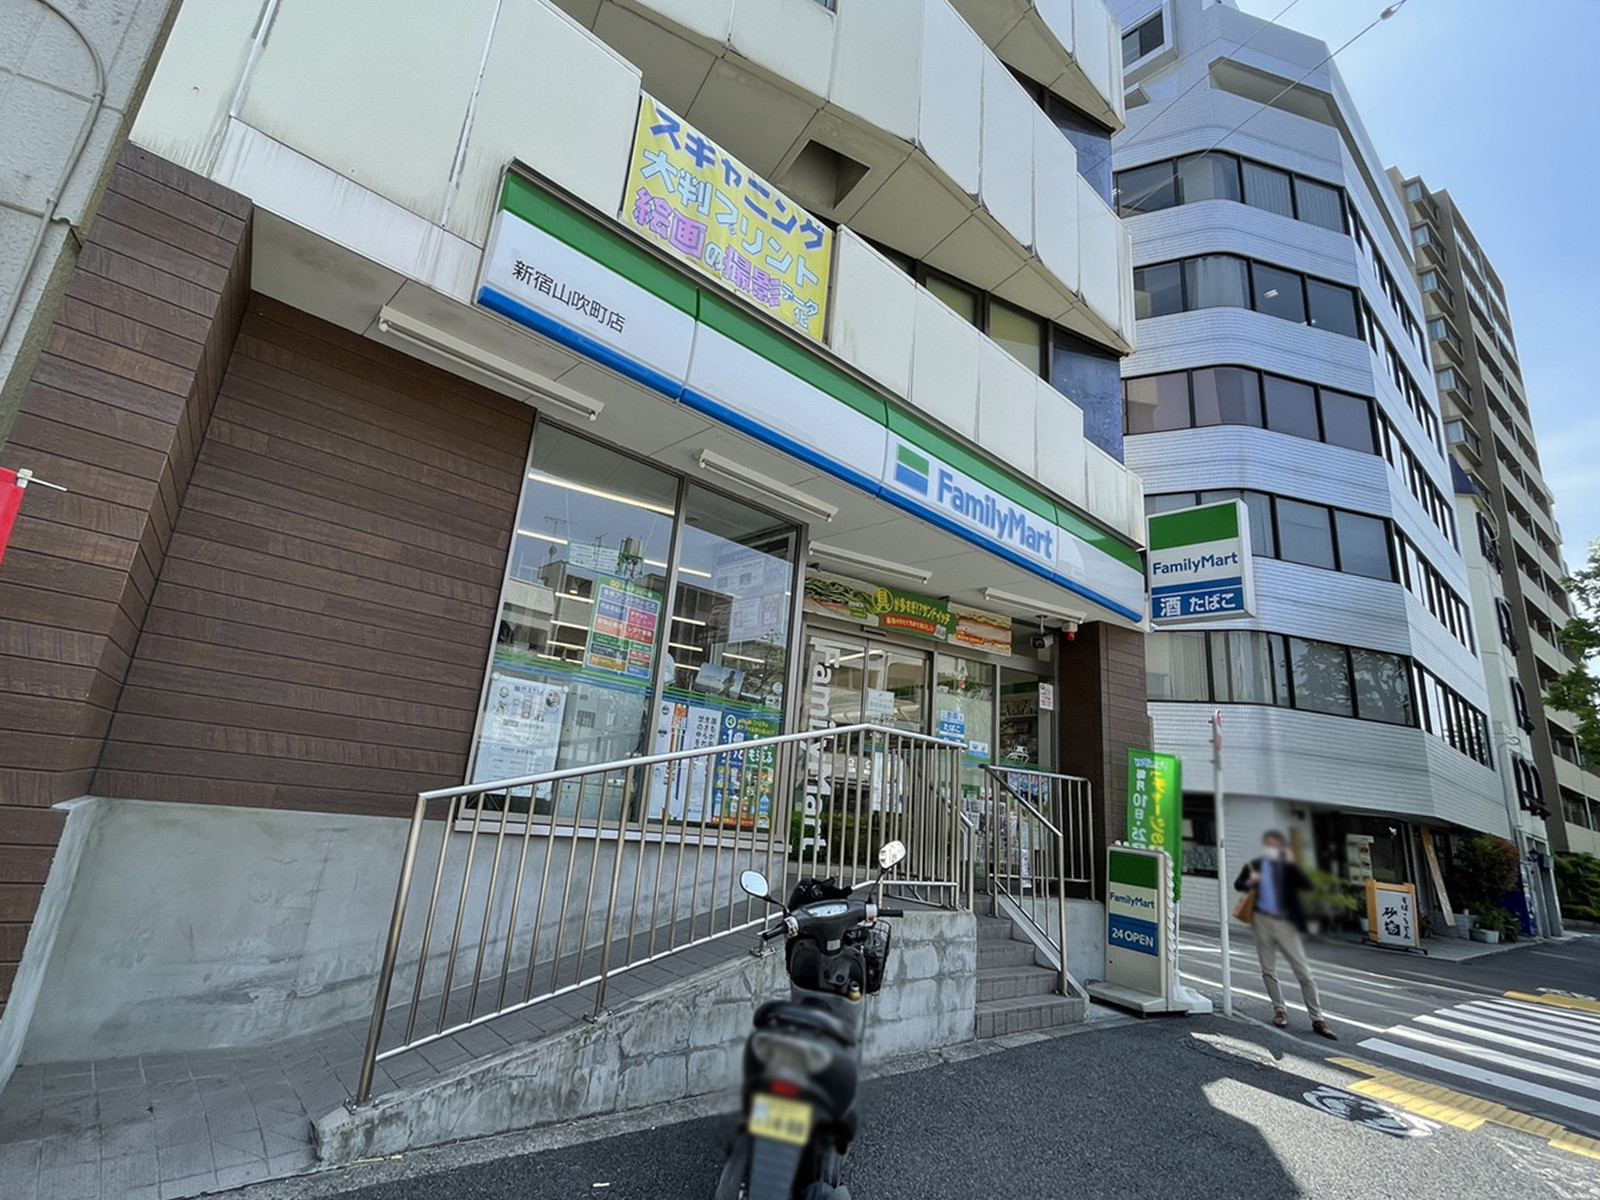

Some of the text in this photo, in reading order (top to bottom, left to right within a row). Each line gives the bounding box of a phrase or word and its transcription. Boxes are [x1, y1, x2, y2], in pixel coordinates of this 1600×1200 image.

[650, 107, 825, 250] スキャニング
[641, 149, 819, 288] 大判プリント
[512, 259, 626, 333] 新宿山吹町店
[936, 467, 1053, 559] FamilyMart
[1152, 551, 1239, 575] FamilyMart
[1160, 592, 1236, 617] 酒 たばこ
[1109, 891, 1155, 909] FamilyMart
